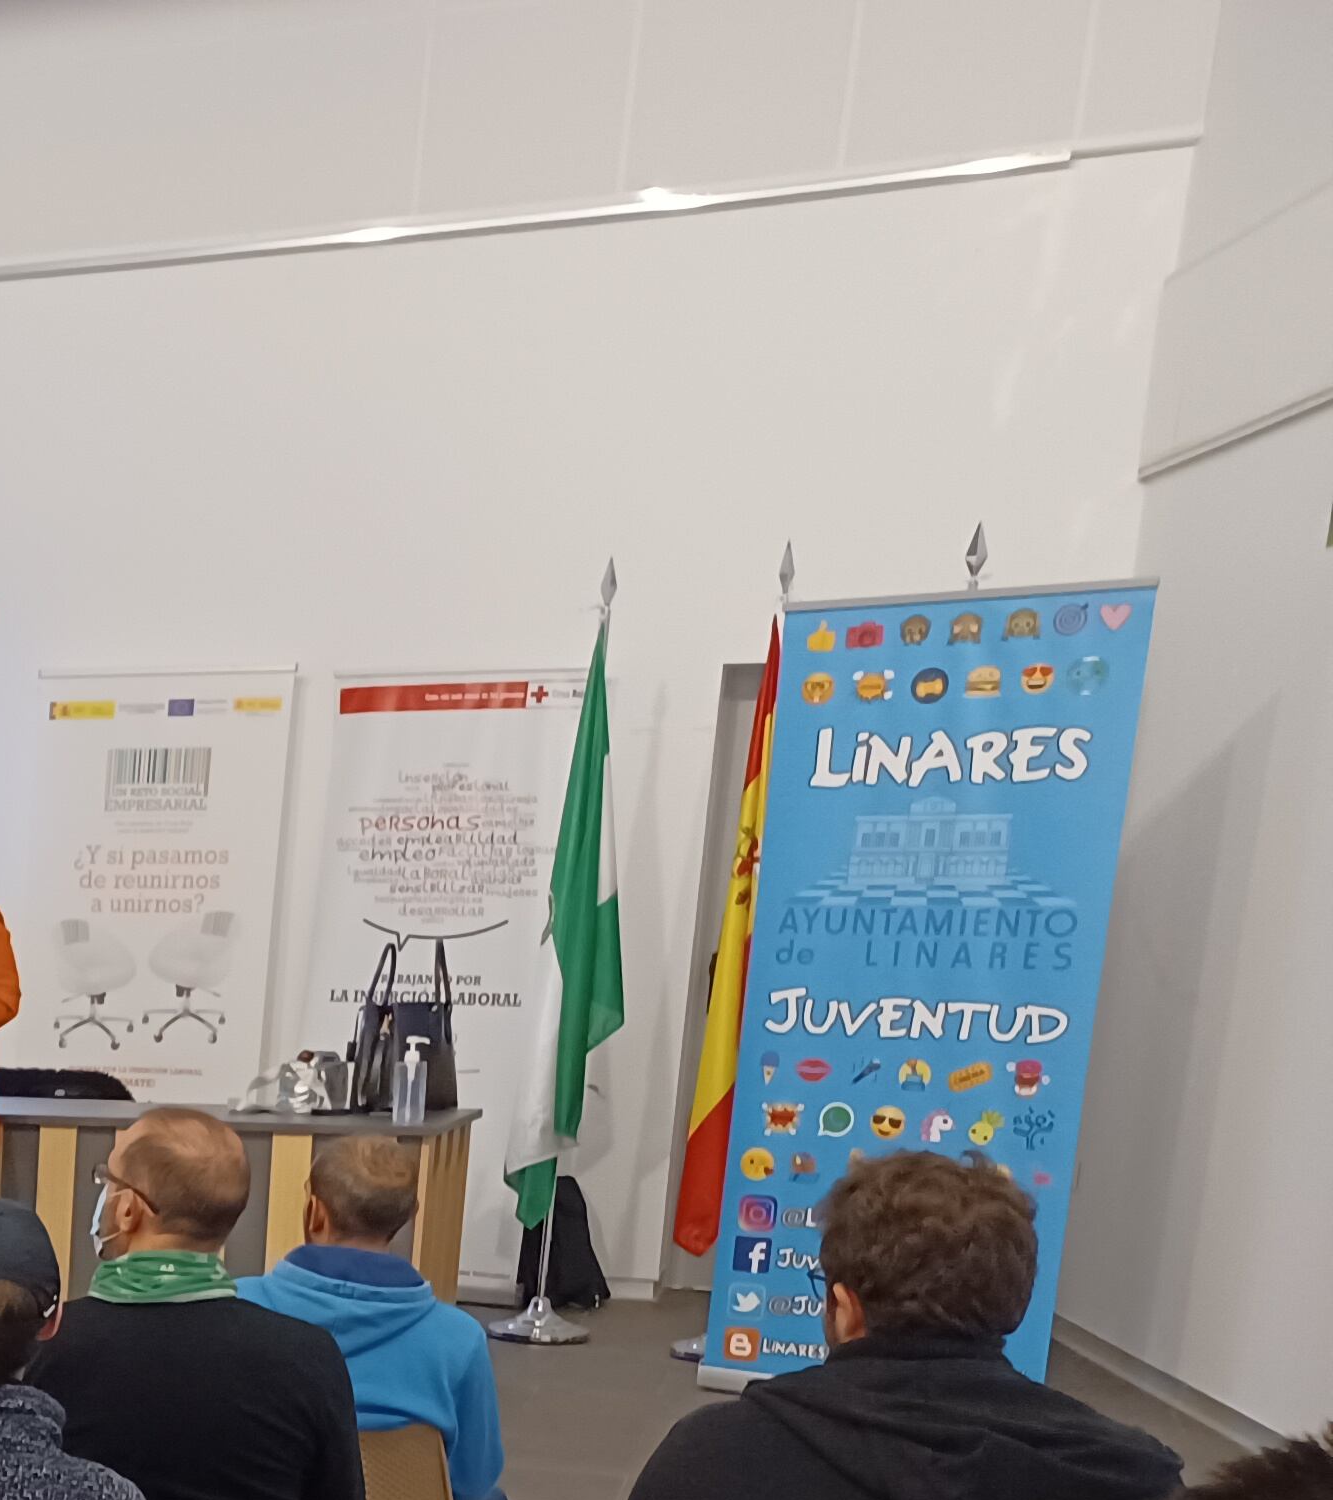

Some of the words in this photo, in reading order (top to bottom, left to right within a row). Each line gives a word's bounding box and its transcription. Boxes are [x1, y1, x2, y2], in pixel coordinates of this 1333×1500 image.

[104, 798, 207, 812] EMPRESARIAL
[130, 848, 230, 870] pasamos
[79, 869, 106, 889] de
[113, 870, 221, 890] reunirnos
[90, 897, 102, 913] a
[109, 893, 205, 914] unirnos?
[778, 906, 1079, 939] AYUNTAMIENTO
[775, 938, 815, 967] de
[864, 938, 1073, 971] LINARES
[455, 974, 482, 987] POR
[329, 988, 349, 1003] LA
[764, 986, 1069, 1044] JUVENTUD
[782, 1207, 817, 1228] @L
[776, 1247, 821, 1271] JUV
[768, 1295, 823, 1317] @JU
